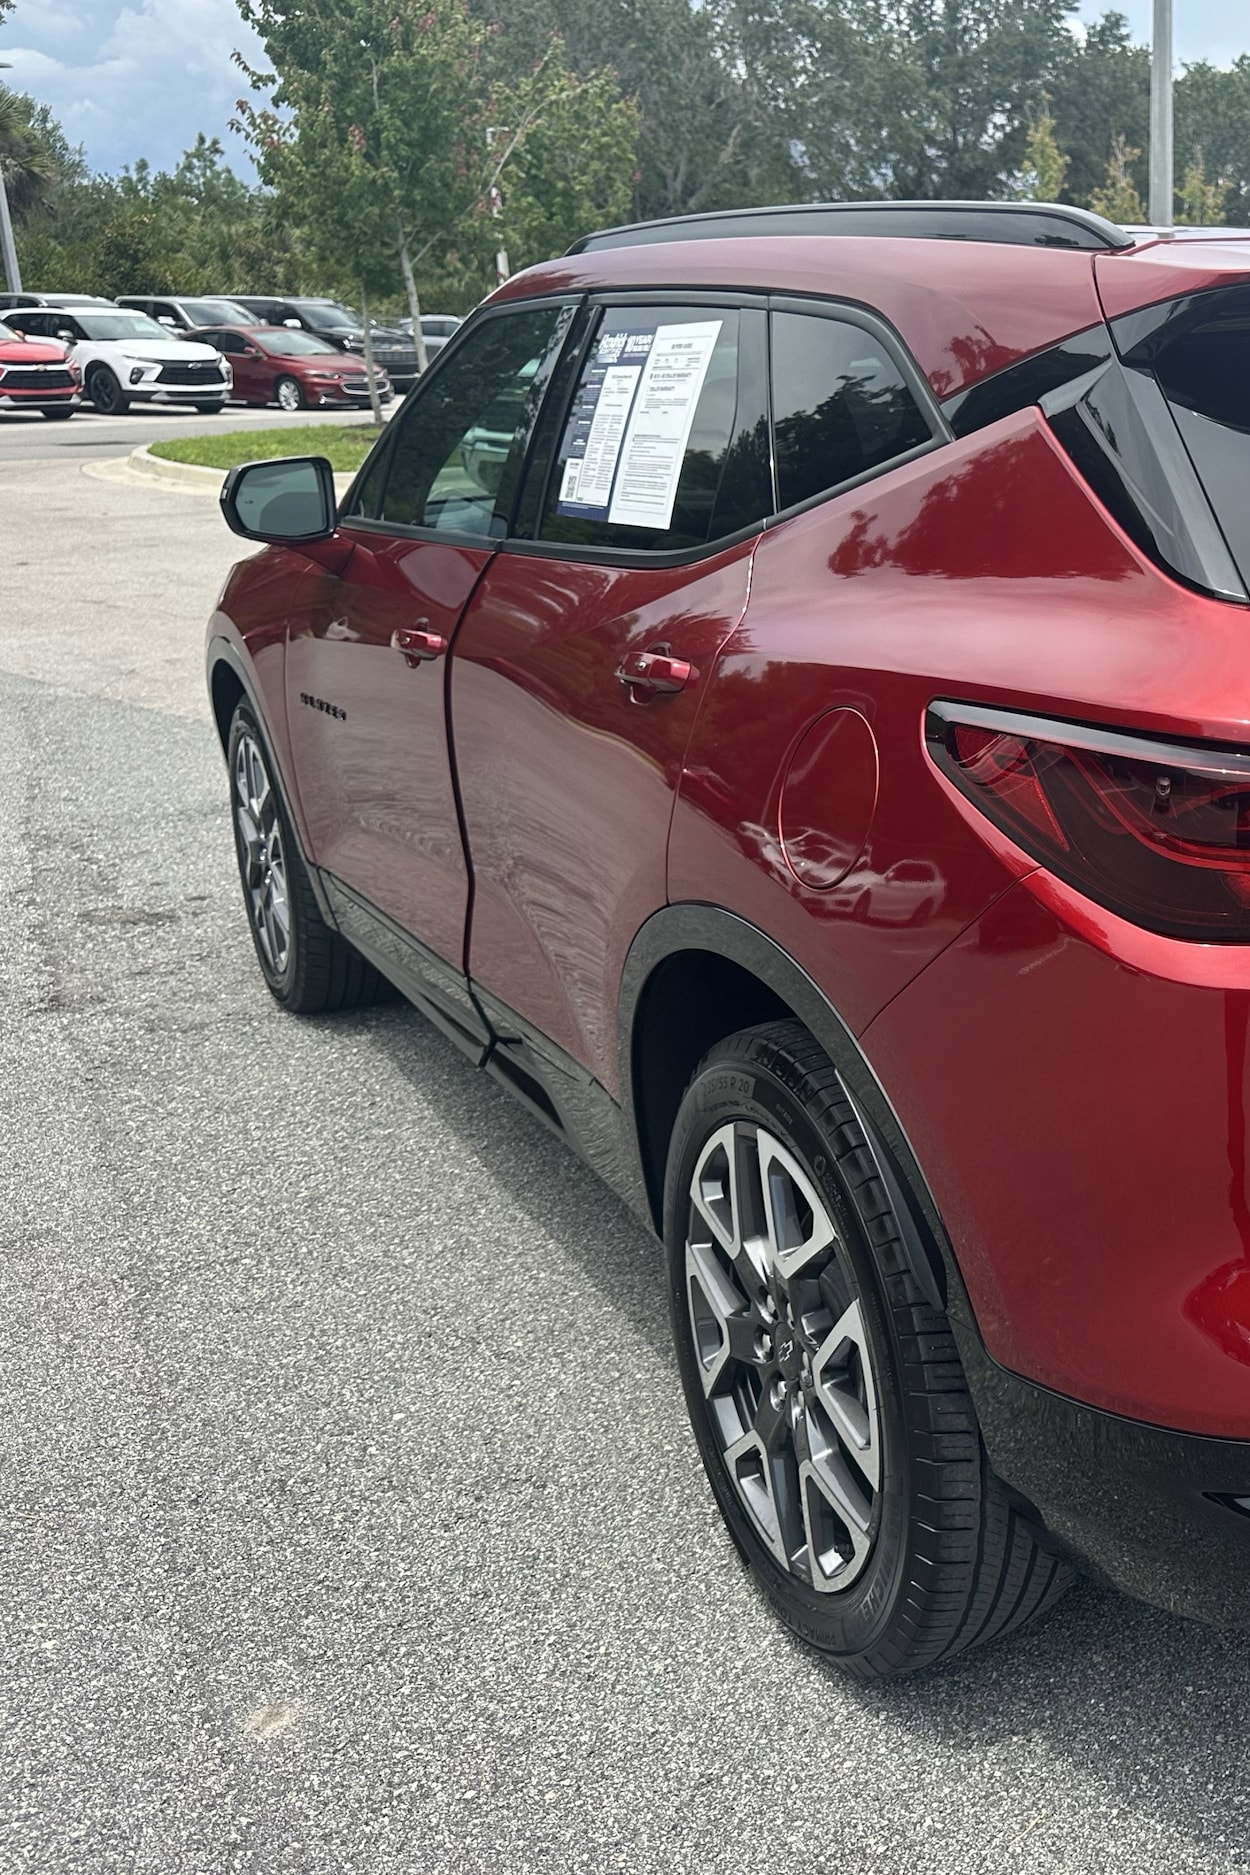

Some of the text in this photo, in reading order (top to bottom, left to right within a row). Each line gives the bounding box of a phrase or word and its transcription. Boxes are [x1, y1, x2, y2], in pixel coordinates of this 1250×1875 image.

[738, 1078, 750, 1094] 20
[769, 1596, 836, 1646] PRIMACY TOUR
